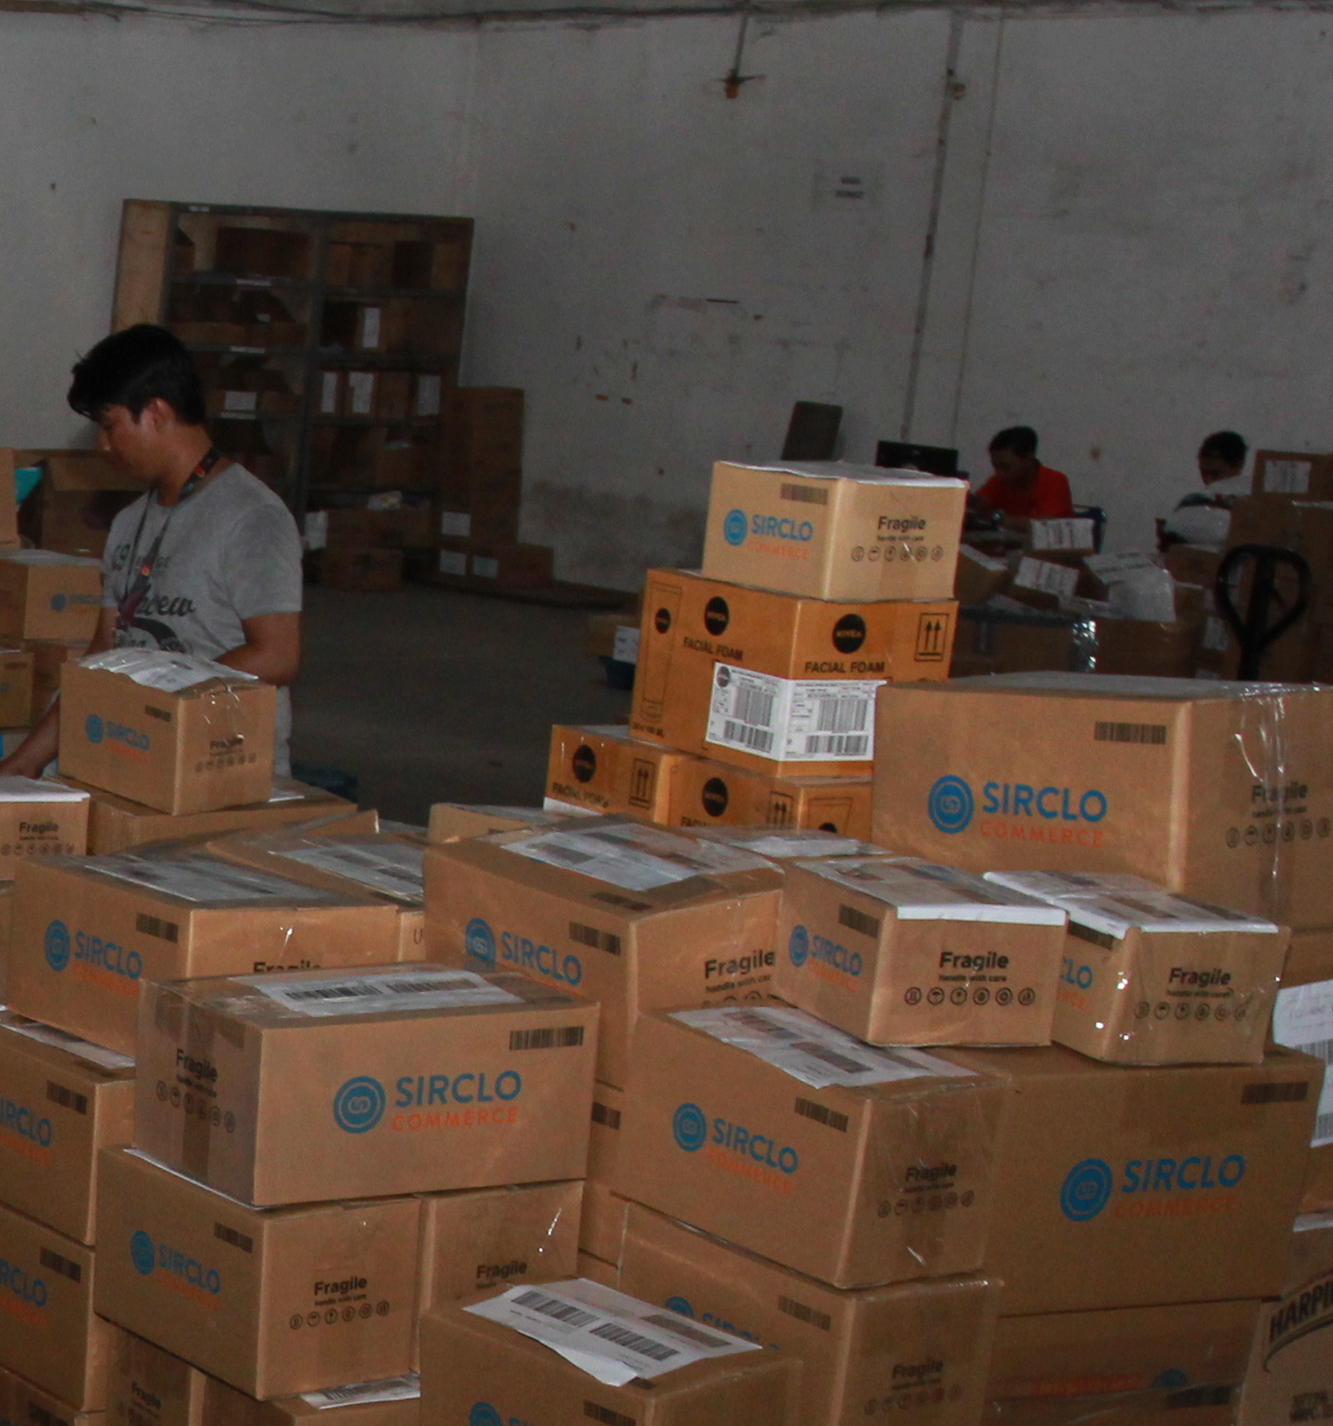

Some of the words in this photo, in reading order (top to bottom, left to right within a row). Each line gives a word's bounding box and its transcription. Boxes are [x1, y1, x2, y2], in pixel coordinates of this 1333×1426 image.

[751, 514, 814, 542] SIRCLO
[877, 515, 927, 534] Fragile
[683, 636, 714, 655] FACIAL
[715, 643, 744, 660] FOAM
[804, 661, 847, 674] FACIAL
[850, 660, 886, 674] FOAM
[105, 720, 151, 751] SIRCLO
[553, 782, 585, 806] FACIAL
[983, 781, 1107, 823] SIRCLO
[1251, 780, 1309, 804] Fragile
[19, 821, 59, 833] Fragile
[979, 820, 1104, 848] COMMERCE
[74, 931, 143, 979] SIRCLO
[501, 936, 583, 986] SIRCLO
[704, 949, 776, 977] Fragile
[810, 932, 863, 977] SIRCLO
[939, 951, 1010, 972] Fragile
[1168, 967, 1232, 989] Fragile
[175, 1047, 218, 1083] Fragile
[395, 1070, 522, 1108] SIRCLO
[391, 1106, 519, 1132] COMMERCE
[712, 1118, 799, 1175] SIRCLO
[905, 1161, 957, 1184] Fragile
[1121, 1154, 1245, 1193] SIRCLO
[1114, 1194, 1237, 1219] COMMERCE
[157, 1243, 221, 1295] SIRCLO
[476, 1259, 528, 1280] Fragile
[313, 1276, 368, 1299] Fragile
[892, 1360, 943, 1379] Fragile
